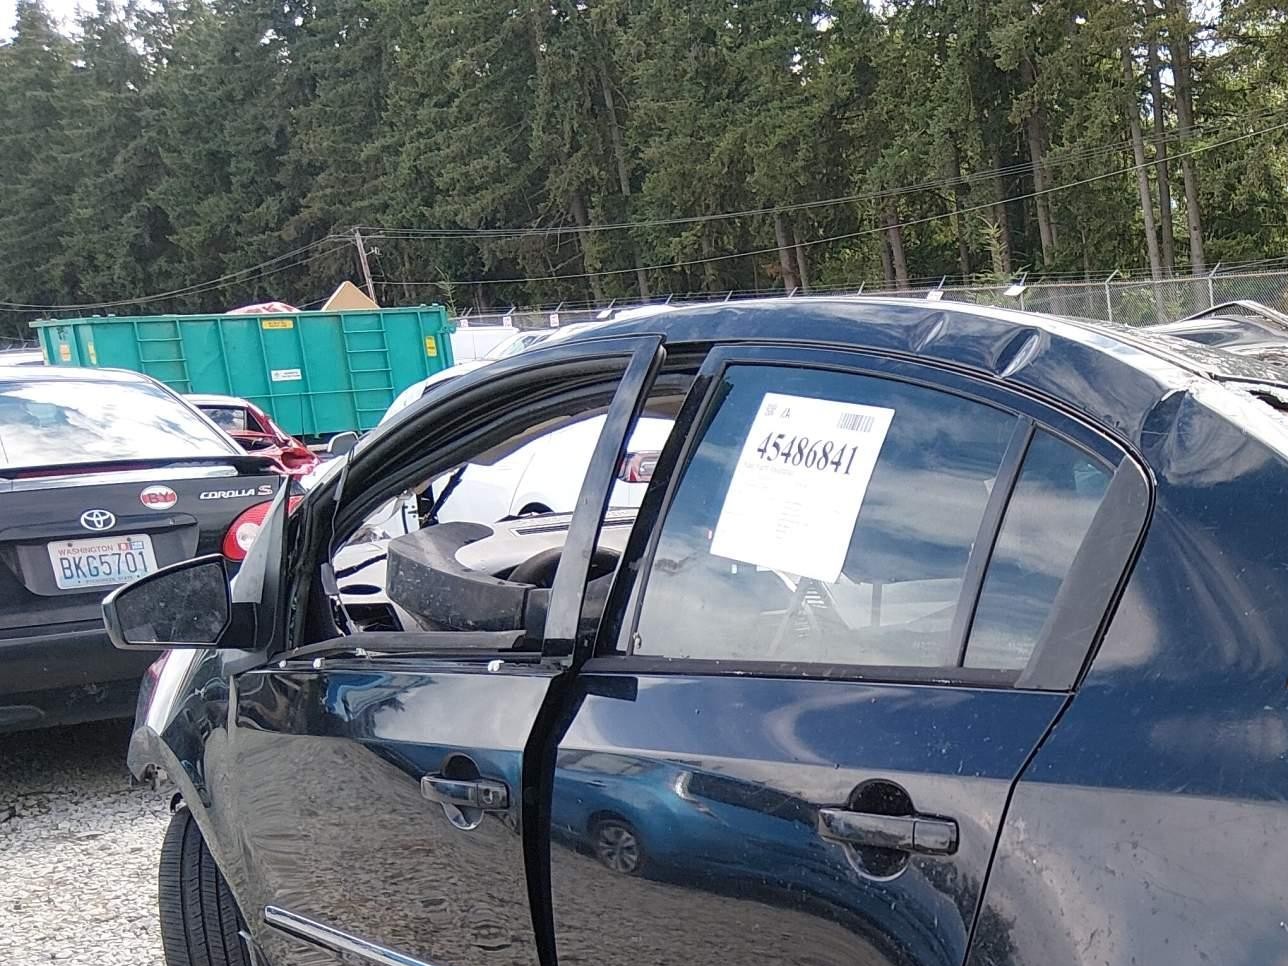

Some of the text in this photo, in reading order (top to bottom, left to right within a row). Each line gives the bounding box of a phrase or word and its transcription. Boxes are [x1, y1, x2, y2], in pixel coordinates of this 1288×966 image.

[757, 431, 858, 475] 45486841
[200, 485, 273, 500] COROLLA S
[57, 545, 114, 557] WASHINGTON
[60, 550, 148, 580] BKG5701
